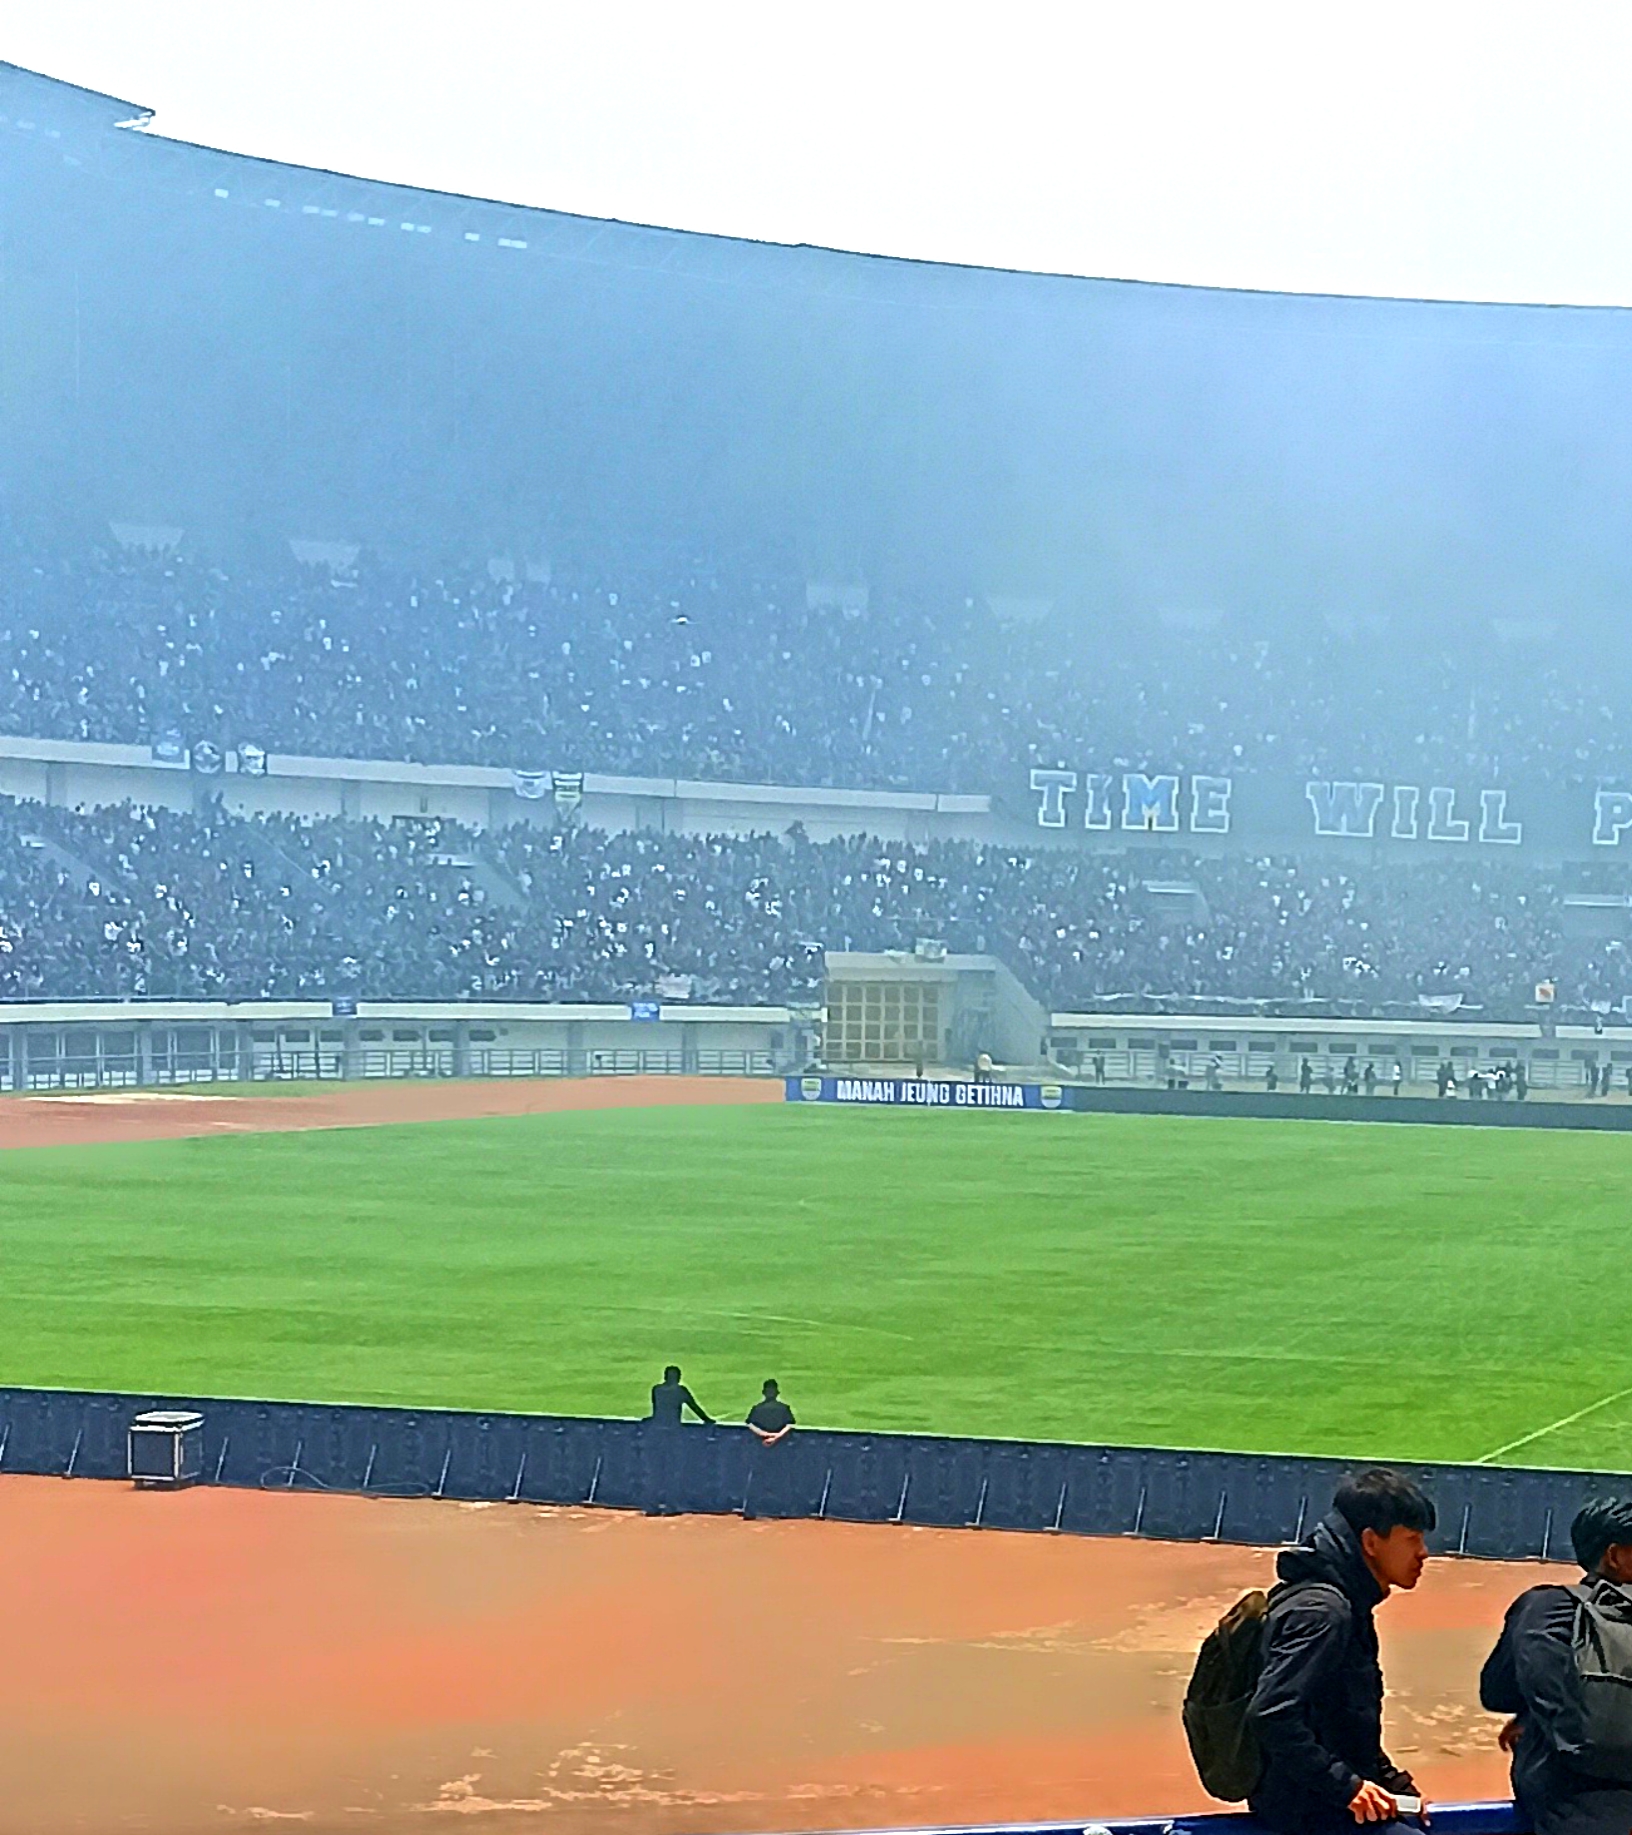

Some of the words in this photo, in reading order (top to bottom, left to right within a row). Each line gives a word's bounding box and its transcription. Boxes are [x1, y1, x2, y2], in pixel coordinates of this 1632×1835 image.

[1030, 769, 1232, 833] TIME
[1305, 781, 1522, 844] WILL
[836, 1080, 895, 1102] MANAH
[900, 1082, 950, 1104] JEUNG
[955, 1084, 1024, 1107] GETIHNA
